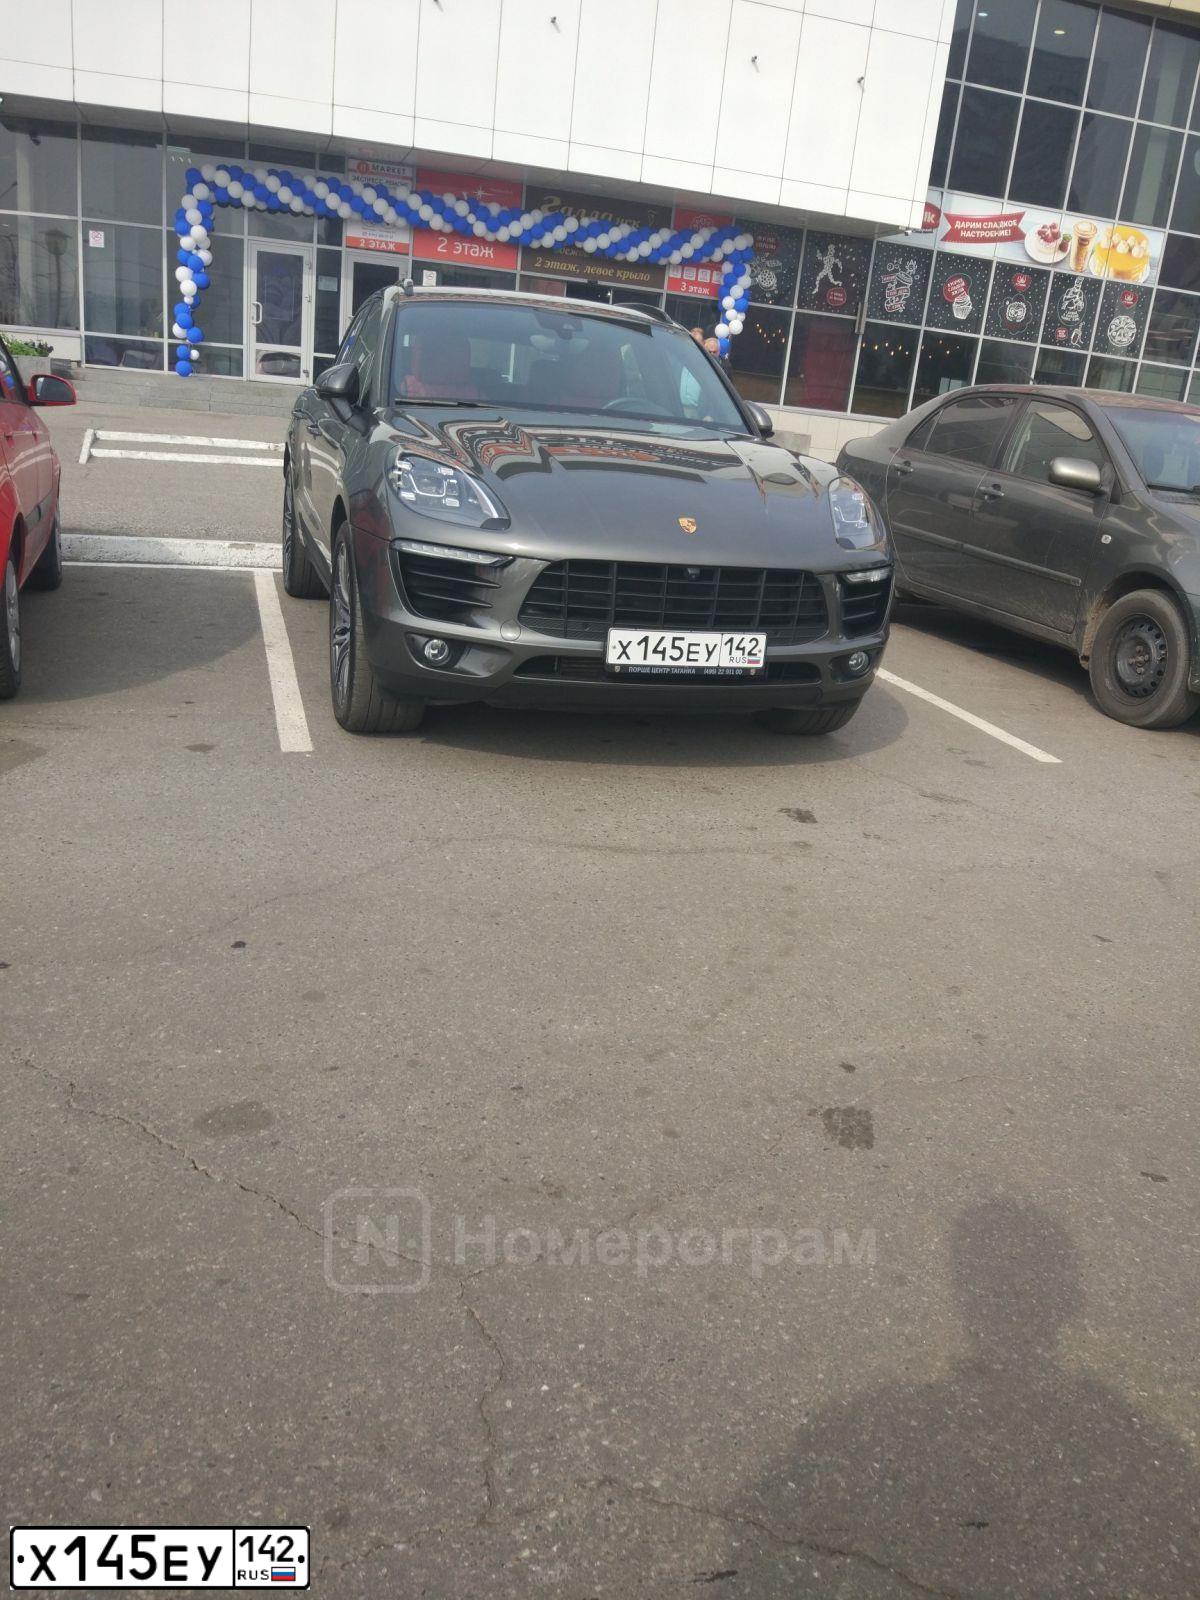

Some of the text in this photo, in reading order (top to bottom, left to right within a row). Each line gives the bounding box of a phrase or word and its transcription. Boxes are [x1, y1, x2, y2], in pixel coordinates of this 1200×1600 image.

[371, 163, 406, 175] MARKET
[954, 219, 1018, 229] ДАРИМ СЛАДКОЕ
[960, 229, 1012, 238] НАСТРОЕНИЕ!
[359, 238, 396, 251] 2 ЭТАЖ
[437, 236, 495, 259] 2 этаж
[534, 256, 651, 282] 2 этаж, левое крыло
[680, 281, 710, 296] 3 этаж
[616, 635, 760, 663] Х145ЕУ 142
[729, 656, 747, 664] RUS
[628, 666, 650, 674] ПОРШЕ
[671, 667, 696, 675] ТАГАНКА
